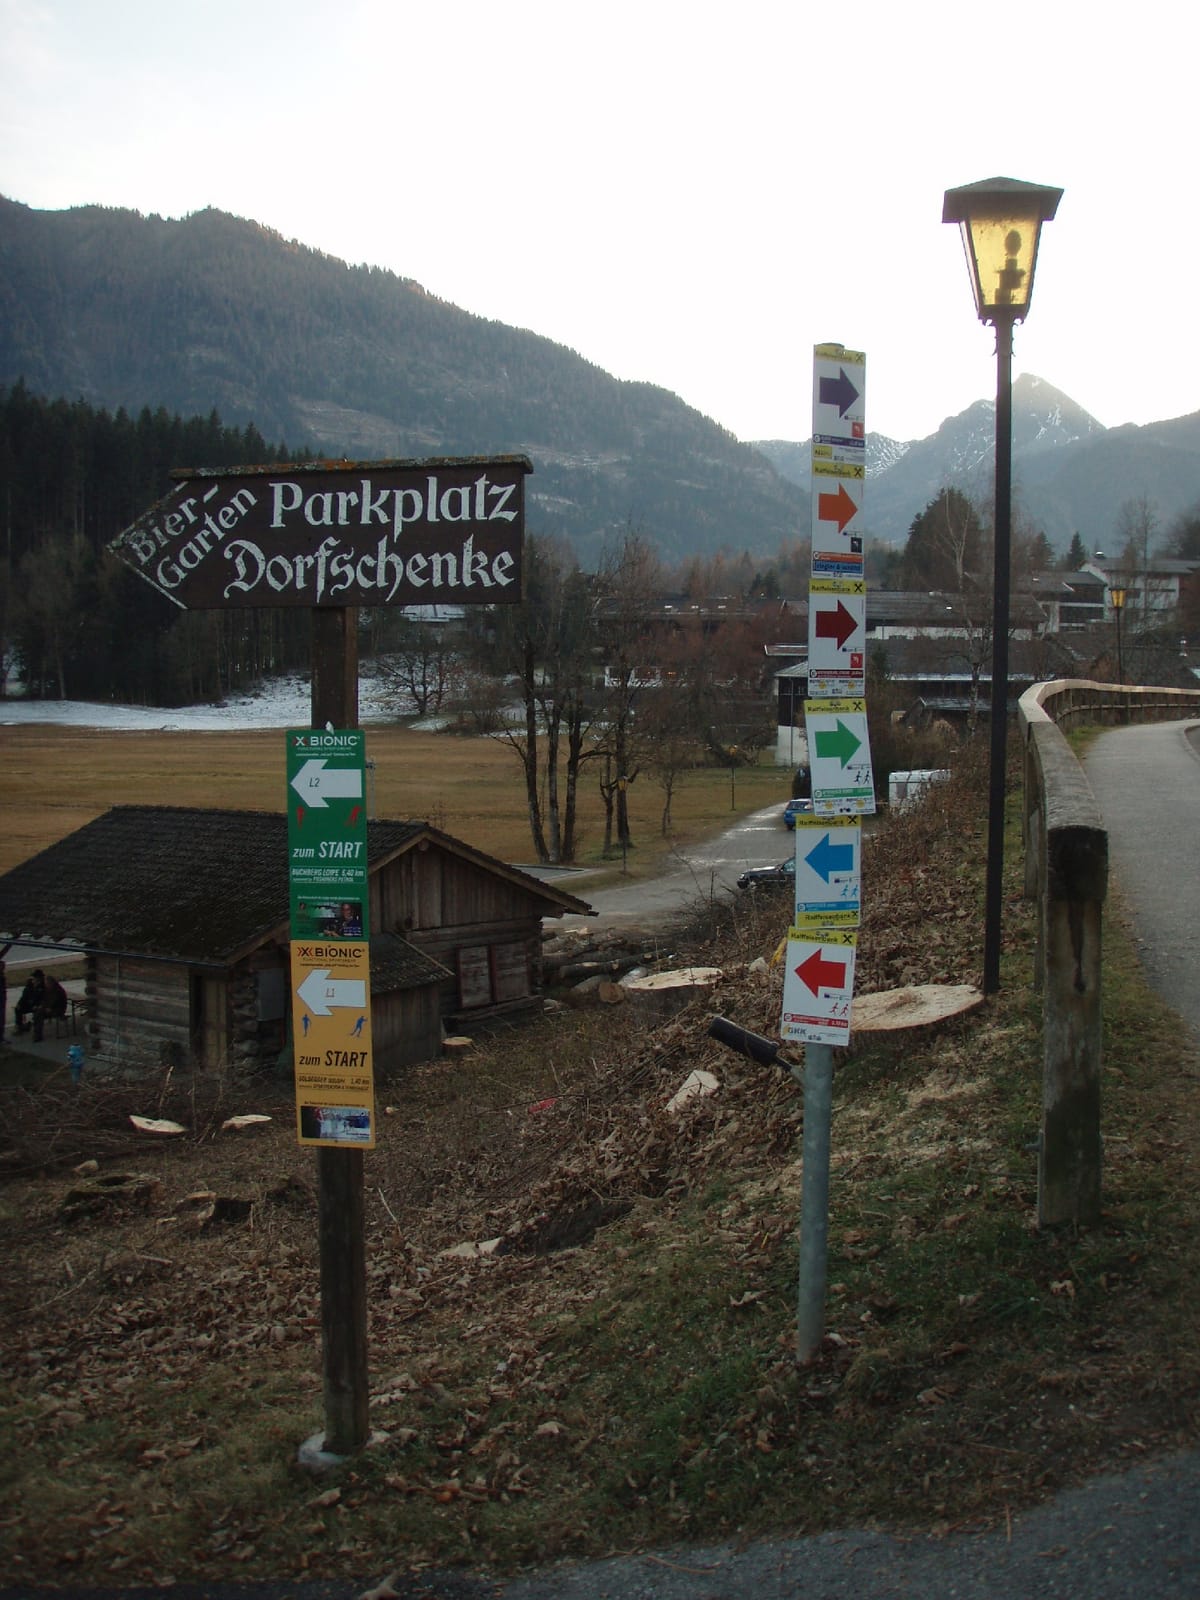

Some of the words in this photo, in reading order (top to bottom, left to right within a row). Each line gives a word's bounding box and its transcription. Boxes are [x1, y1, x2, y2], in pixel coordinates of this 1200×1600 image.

[269, 473, 518, 543] Parkplatz
[156, 487, 259, 589] Garten
[223, 534, 515, 604] Dorfschenke
[309, 778, 320, 787] L2
[293, 847, 315, 858] zum
[318, 841, 363, 859] START
[355, 869, 364, 877] km
[299, 1055, 321, 1066] zum
[325, 1050, 368, 1067] START
